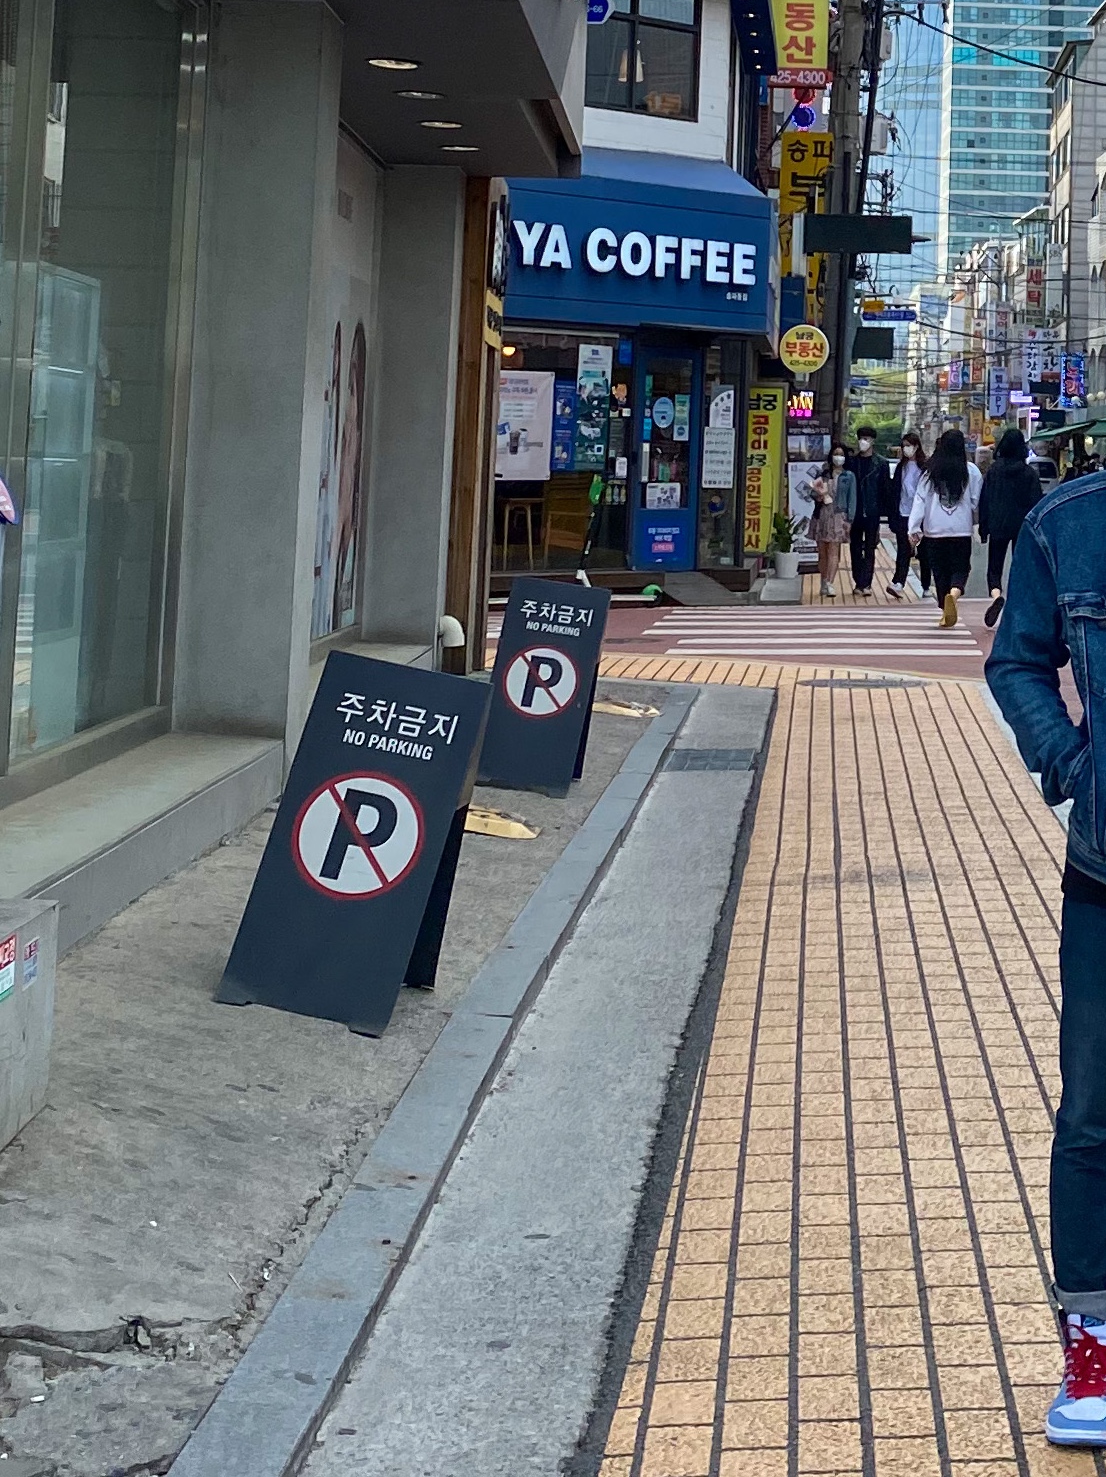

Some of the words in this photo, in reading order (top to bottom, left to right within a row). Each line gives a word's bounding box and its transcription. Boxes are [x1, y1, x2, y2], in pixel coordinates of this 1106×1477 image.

[769, 70, 826, 84] 425-4300
[787, 140, 834, 163] 송파
[513, 220, 572, 269] YA
[587, 227, 757, 286] COFFEE
[1027, 268, 1042, 308] 세탁
[785, 342, 824, 358] 부동산
[744, 467, 763, 551] 공인중개사
[520, 599, 594, 627] 주차금지
[526, 621, 539, 632] NO
[541, 623, 580, 637] PARKING
[335, 693, 459, 745] 주차금지
[343, 728, 366, 747] NO
[368, 733, 433, 762] PARKING
